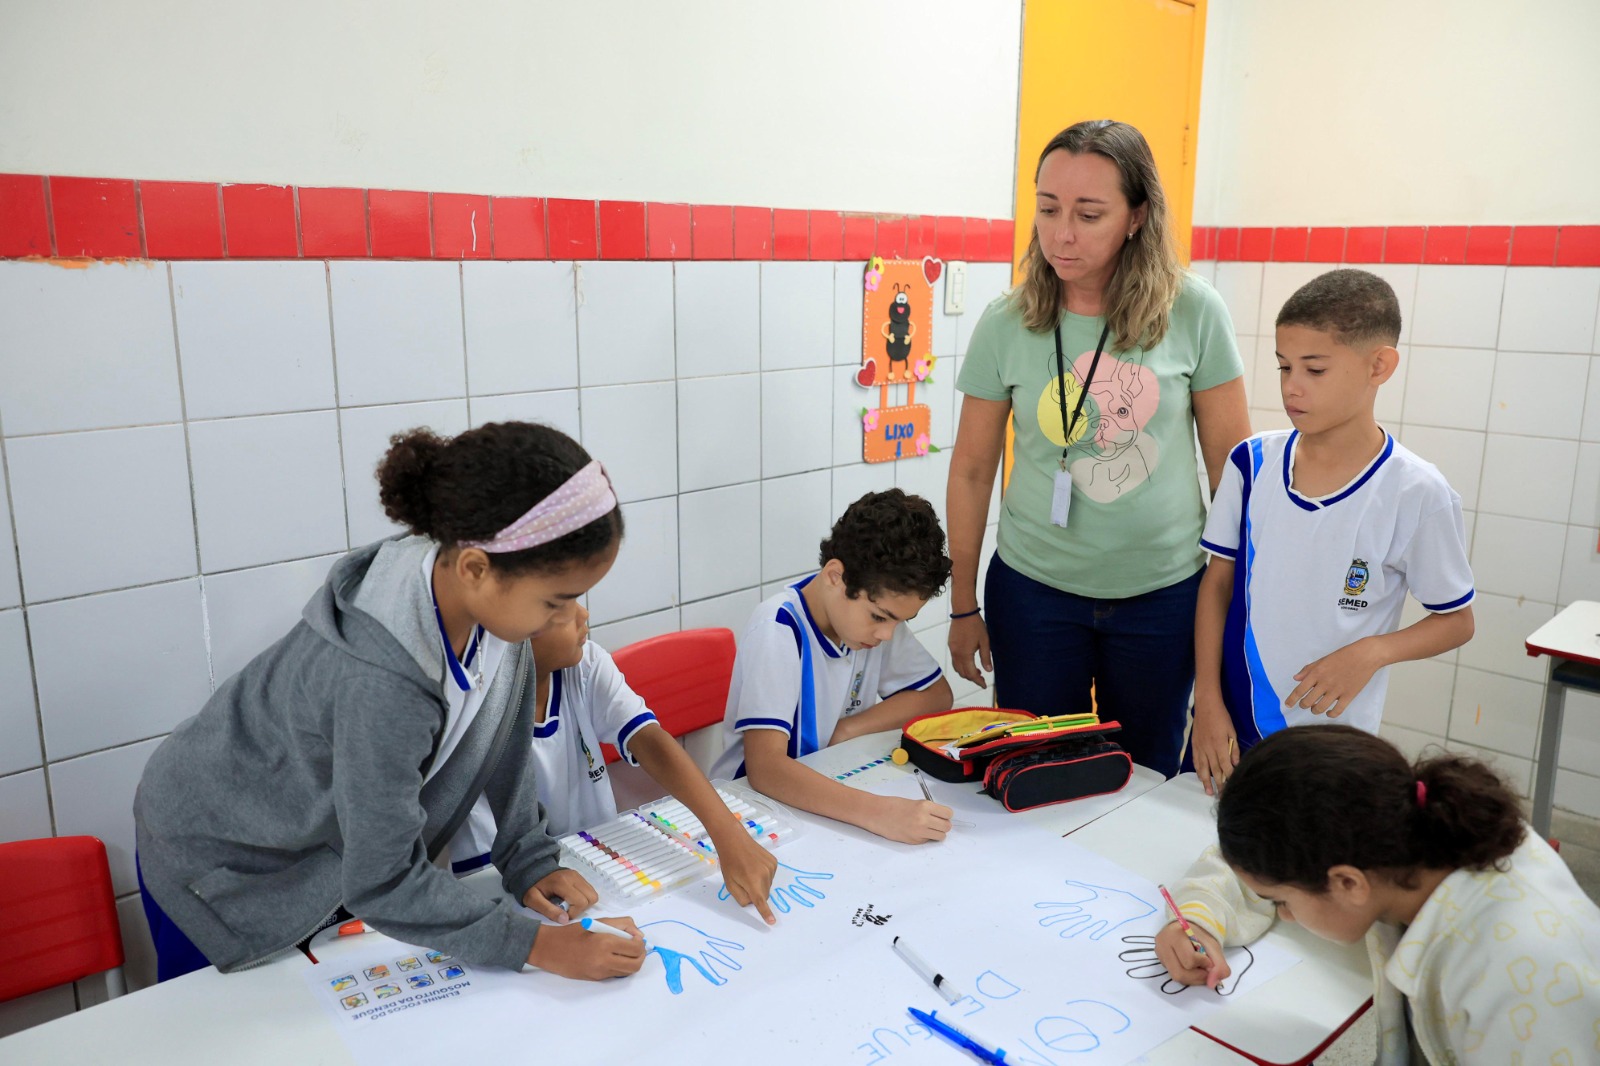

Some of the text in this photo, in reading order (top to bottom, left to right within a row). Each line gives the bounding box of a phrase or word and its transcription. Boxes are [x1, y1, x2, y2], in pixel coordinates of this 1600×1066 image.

[885, 422, 914, 441] LIXO
[1338, 597, 1368, 608] SEMED
[351, 980, 471, 1021] MOSQUITO DA DENGUE
[370, 990, 460, 1020] ELIMINE FOCOS DO
